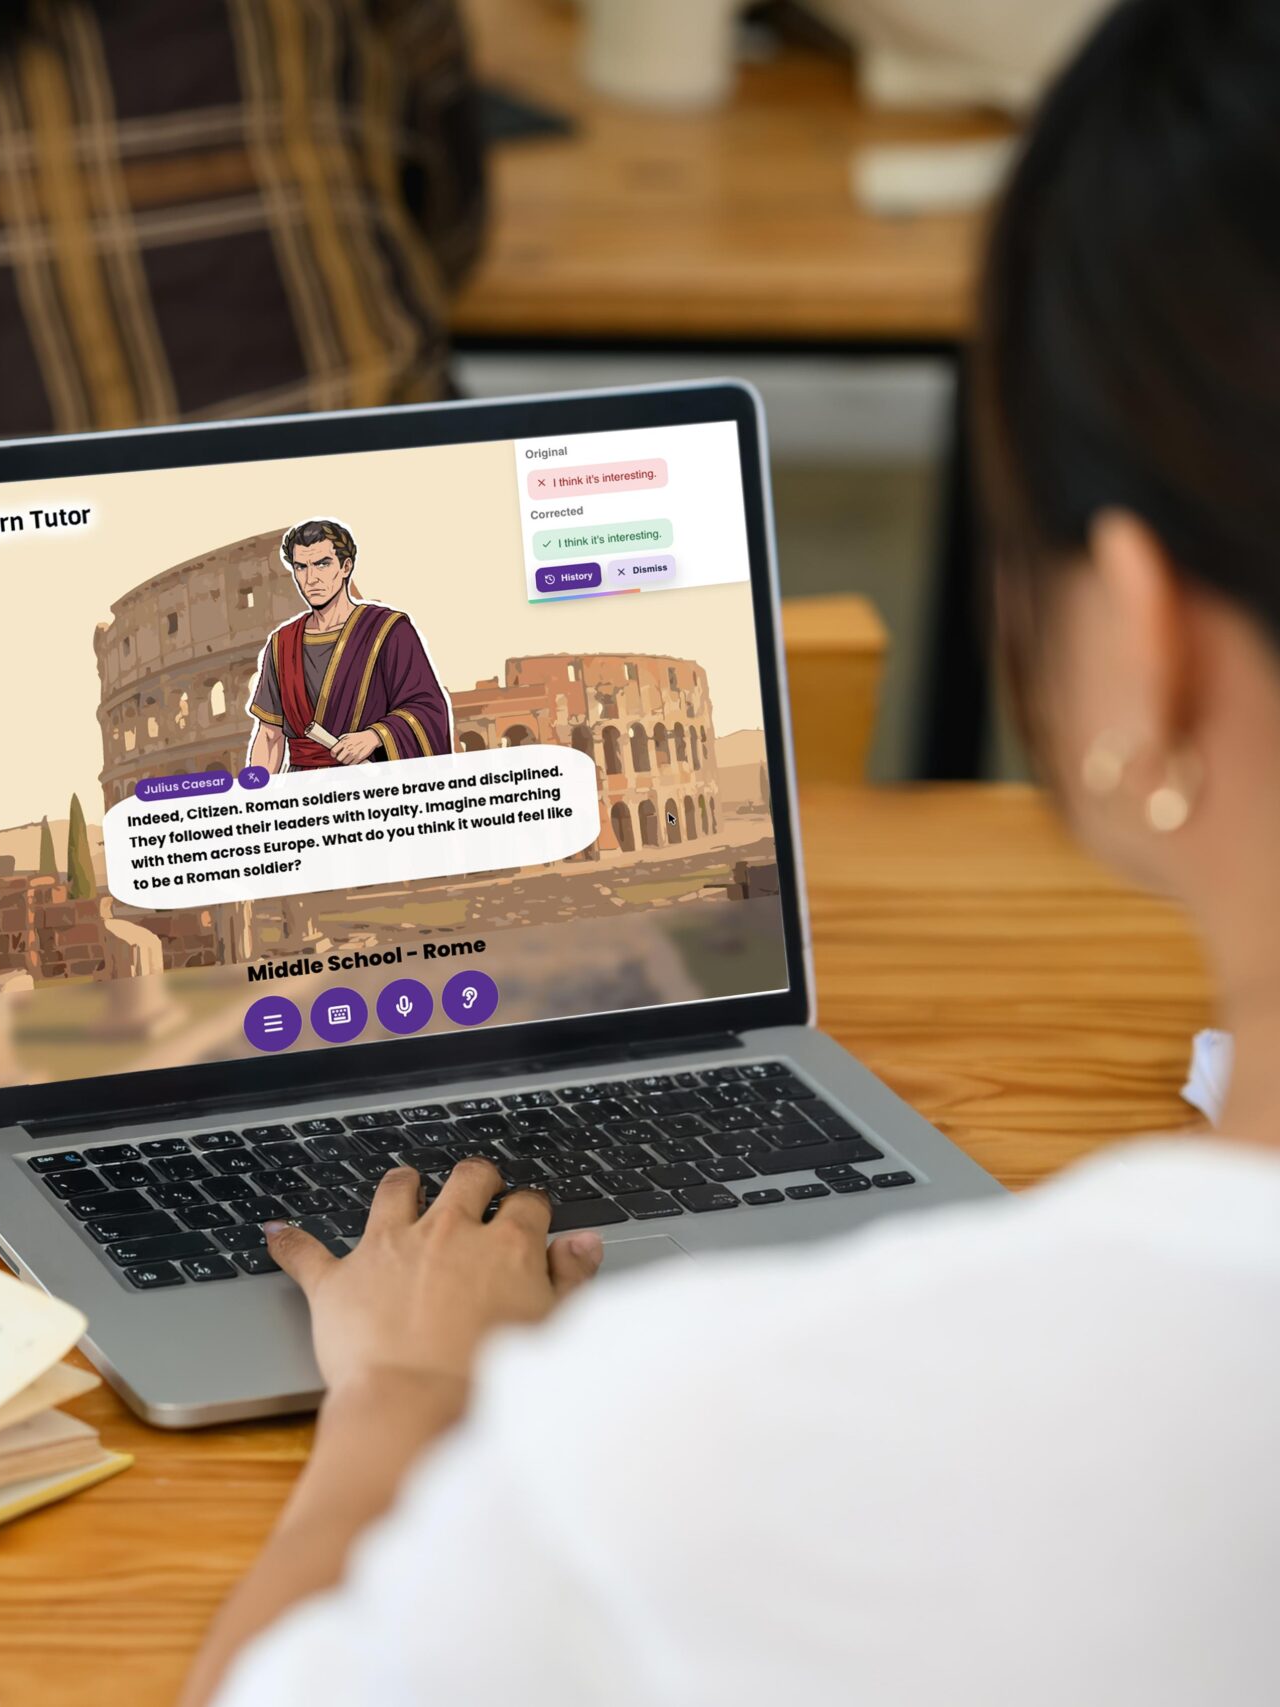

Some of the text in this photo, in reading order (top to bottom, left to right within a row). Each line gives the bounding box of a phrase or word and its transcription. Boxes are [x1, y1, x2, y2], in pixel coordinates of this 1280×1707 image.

[525, 446, 568, 460] Original
[553, 469, 658, 488] I think it's interesting.
[29, 508, 91, 529] Tutor
[530, 506, 584, 520] Corrected
[558, 530, 662, 548] I think it's interesting.
[560, 572, 593, 583] History
[632, 564, 668, 575] Dismiss
[144, 777, 225, 795] Julius Caesar
[127, 766, 564, 827] Indeed, Citizen. Roman soldiers were brave and disciplined.
[129, 787, 561, 849] They followed their leaders with loyalty. Imagine marching
[131, 806, 573, 869] with them across Europe. What do you think it would feel like
[133, 859, 302, 890] to be a Roman soldier?
[247, 957, 324, 982] Middle
[327, 946, 402, 972] School
[422, 939, 486, 960] Rome
